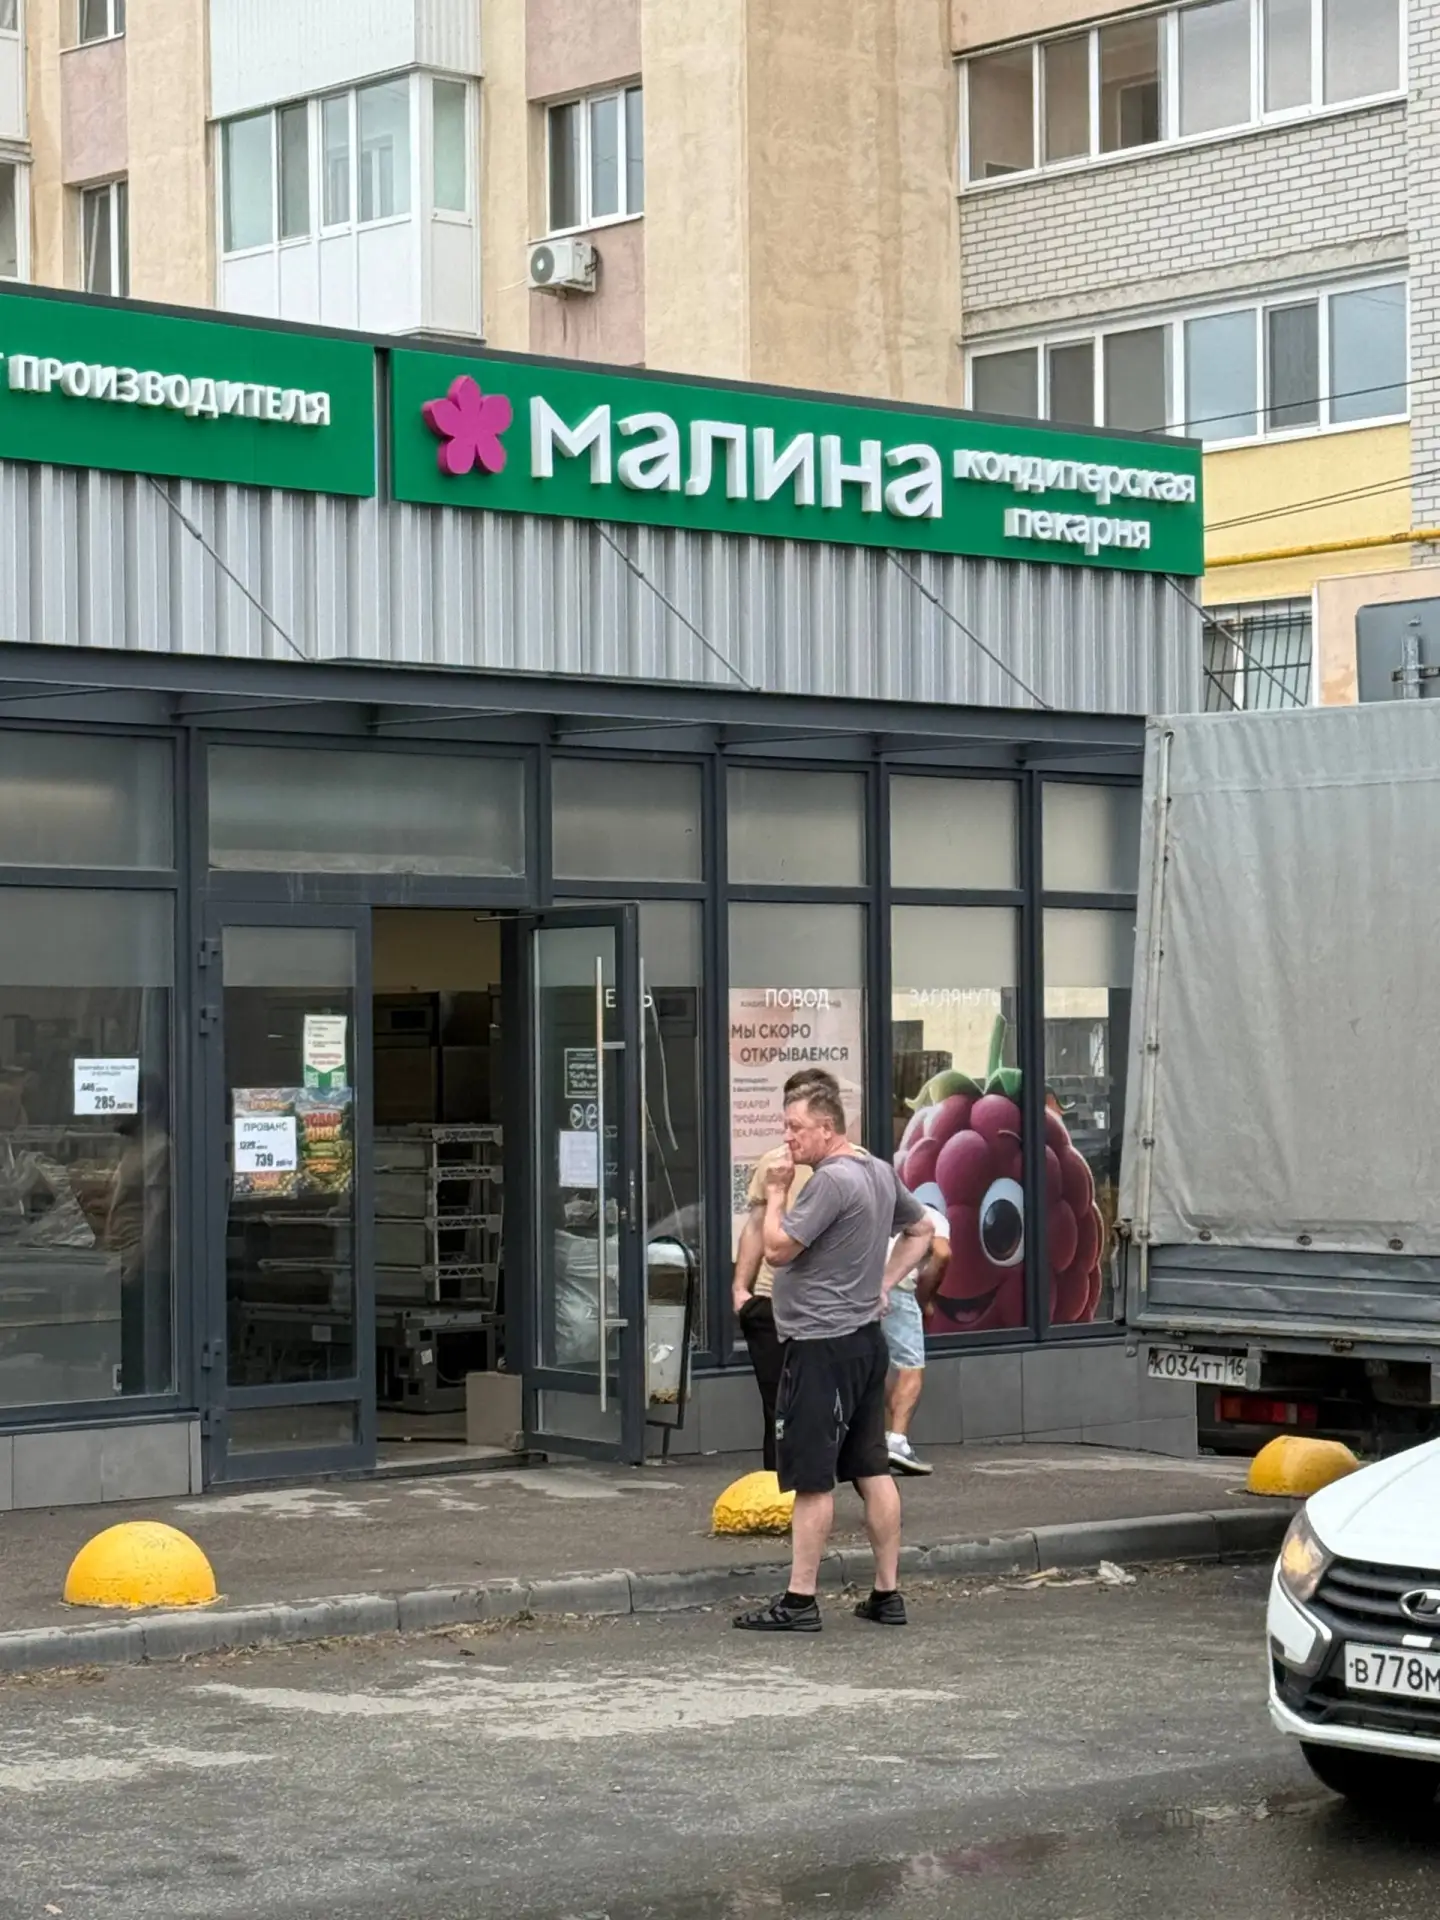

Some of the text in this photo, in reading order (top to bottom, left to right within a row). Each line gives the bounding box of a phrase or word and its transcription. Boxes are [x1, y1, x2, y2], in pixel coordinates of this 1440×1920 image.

[8, 353, 331, 427] ПРОИЗВОДИТЕЛЯ
[529, 394, 943, 519] Малина
[953, 447, 1196, 505] кондитерская
[1004, 506, 1152, 556] пекарня
[765, 988, 830, 1011] ПОВОД
[909, 987, 1001, 1009] ЗАГЛЯНУТЬ
[731, 1023, 812, 1039] МЫ СКОРО
[740, 1046, 850, 1063] ОТКРЫВАЕМСЯ
[94, 1095, 116, 1110] 285
[255, 1152, 274, 1168] 739
